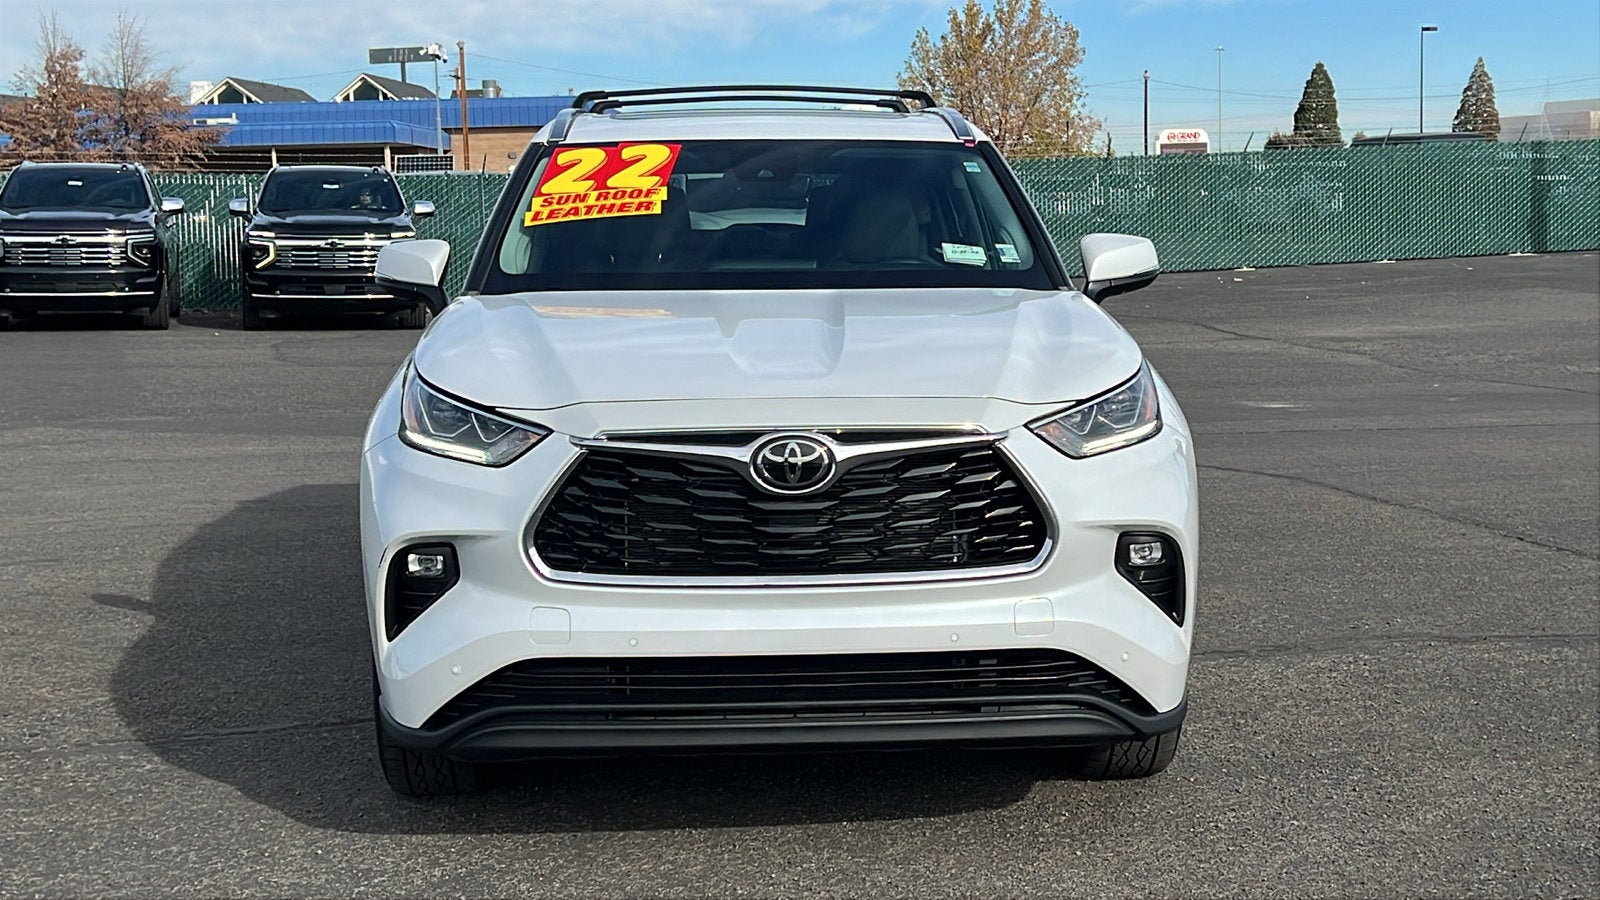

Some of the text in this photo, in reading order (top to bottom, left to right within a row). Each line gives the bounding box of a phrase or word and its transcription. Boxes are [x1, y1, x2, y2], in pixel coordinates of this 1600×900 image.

[540, 187, 661, 208] SUN ROOF
[530, 201, 657, 222] LEATHER
